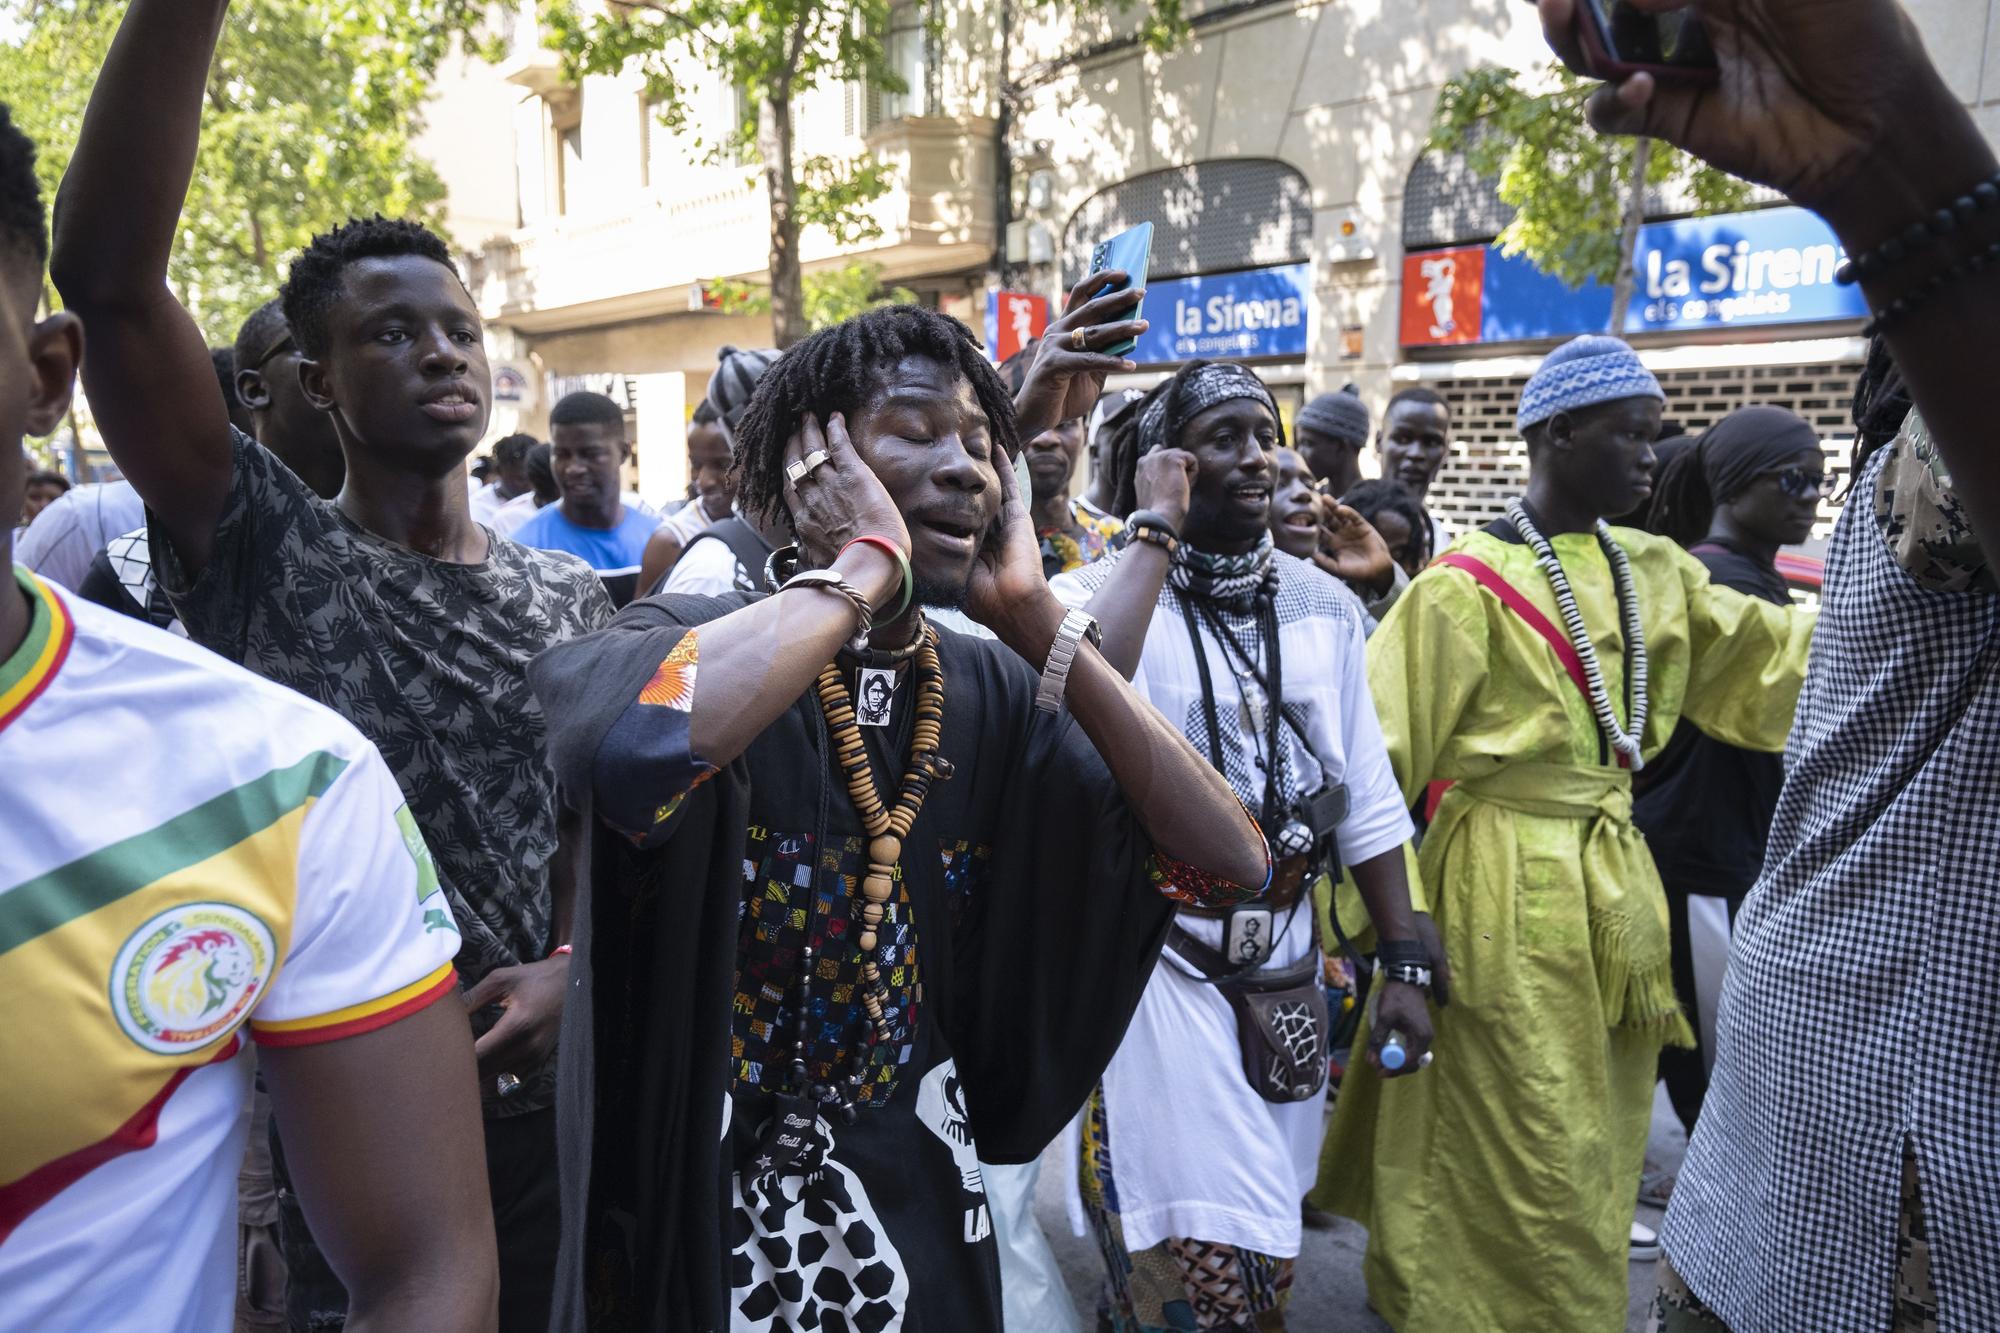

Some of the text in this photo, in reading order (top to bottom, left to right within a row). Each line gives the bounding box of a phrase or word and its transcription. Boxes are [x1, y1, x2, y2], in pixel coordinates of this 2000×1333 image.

[1646, 248, 1690, 299] la
[1176, 294, 1300, 336] la Sirena
[1644, 298, 1678, 322] els
[783, 1113, 811, 1128] Baye
[777, 1134, 801, 1148] Fall
